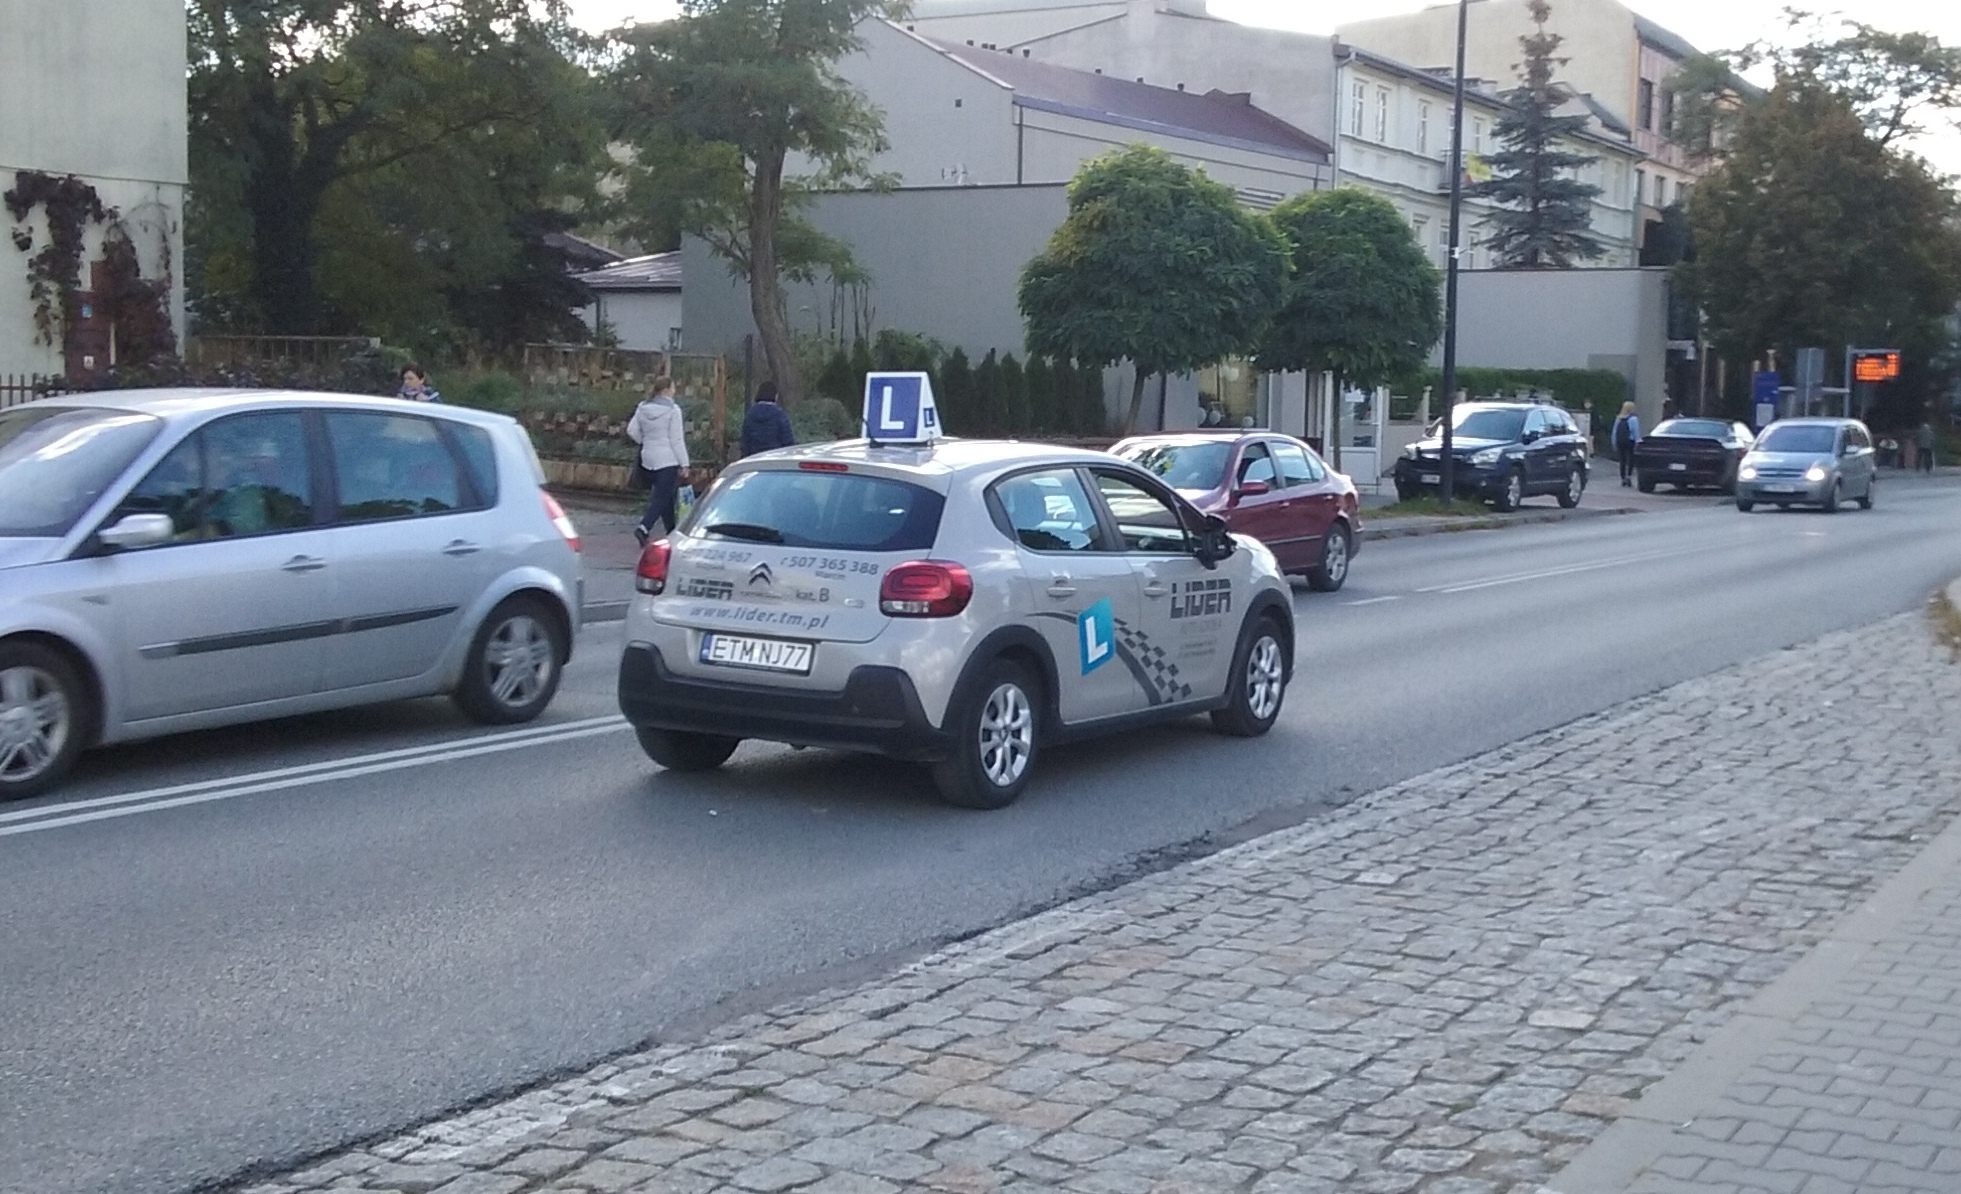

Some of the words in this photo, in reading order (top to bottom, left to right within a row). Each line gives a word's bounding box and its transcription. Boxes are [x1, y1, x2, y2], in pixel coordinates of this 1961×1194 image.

[880, 386, 905, 430] L
[925, 410, 933, 425] L
[728, 551, 752, 564] 967
[788, 556, 817, 568] 507
[818, 557, 848, 570] 365
[849, 561, 879, 575] 388
[676, 577, 735, 601] LIDER
[819, 587, 830, 602] B
[1170, 578, 1232, 619] LIDER
[689, 605, 830, 630] www.lider.tm.pl
[1085, 615, 1109, 665] L
[713, 637, 756, 662] ETM
[758, 642, 808, 668] NJ77
